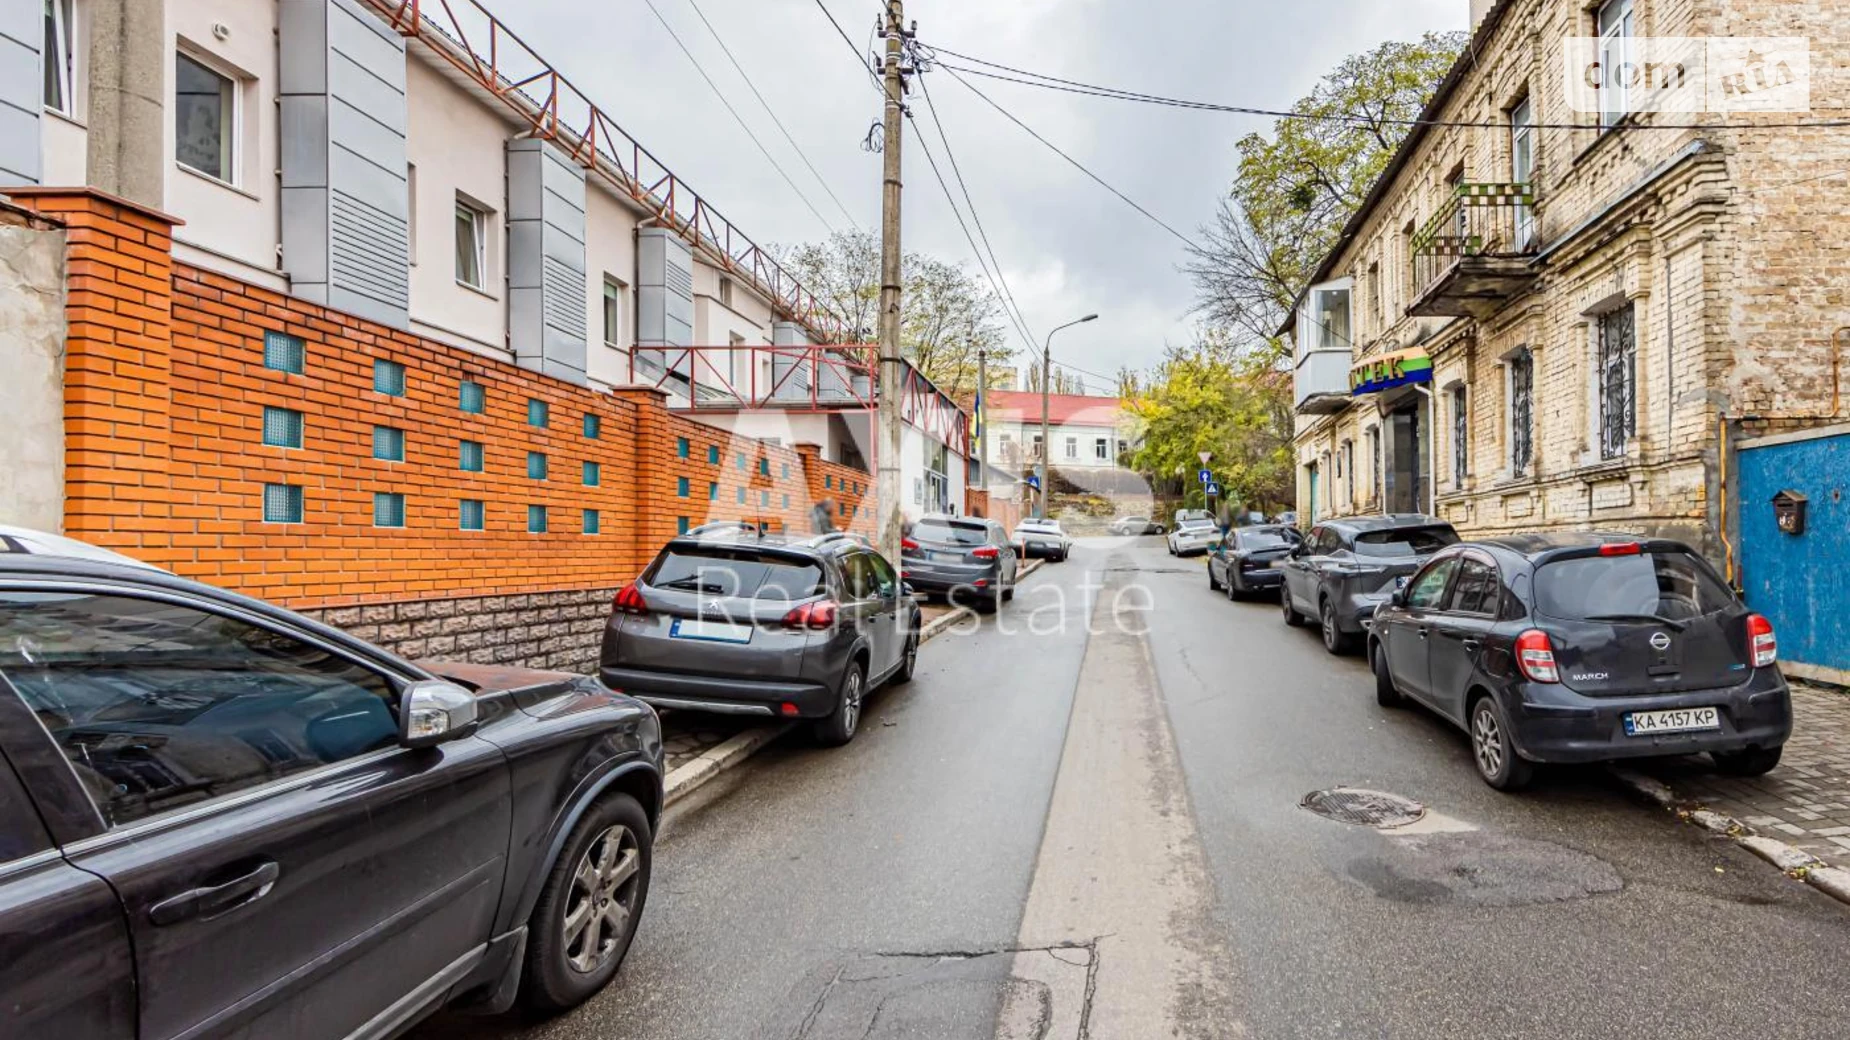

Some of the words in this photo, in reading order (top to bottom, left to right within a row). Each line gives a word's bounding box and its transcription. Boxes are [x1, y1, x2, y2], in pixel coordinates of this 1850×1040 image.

[1572, 672, 1609, 681] MARCH
[1634, 714, 1657, 730] KA
[1659, 711, 1690, 727] 4157
[1693, 709, 1715, 725] KP
